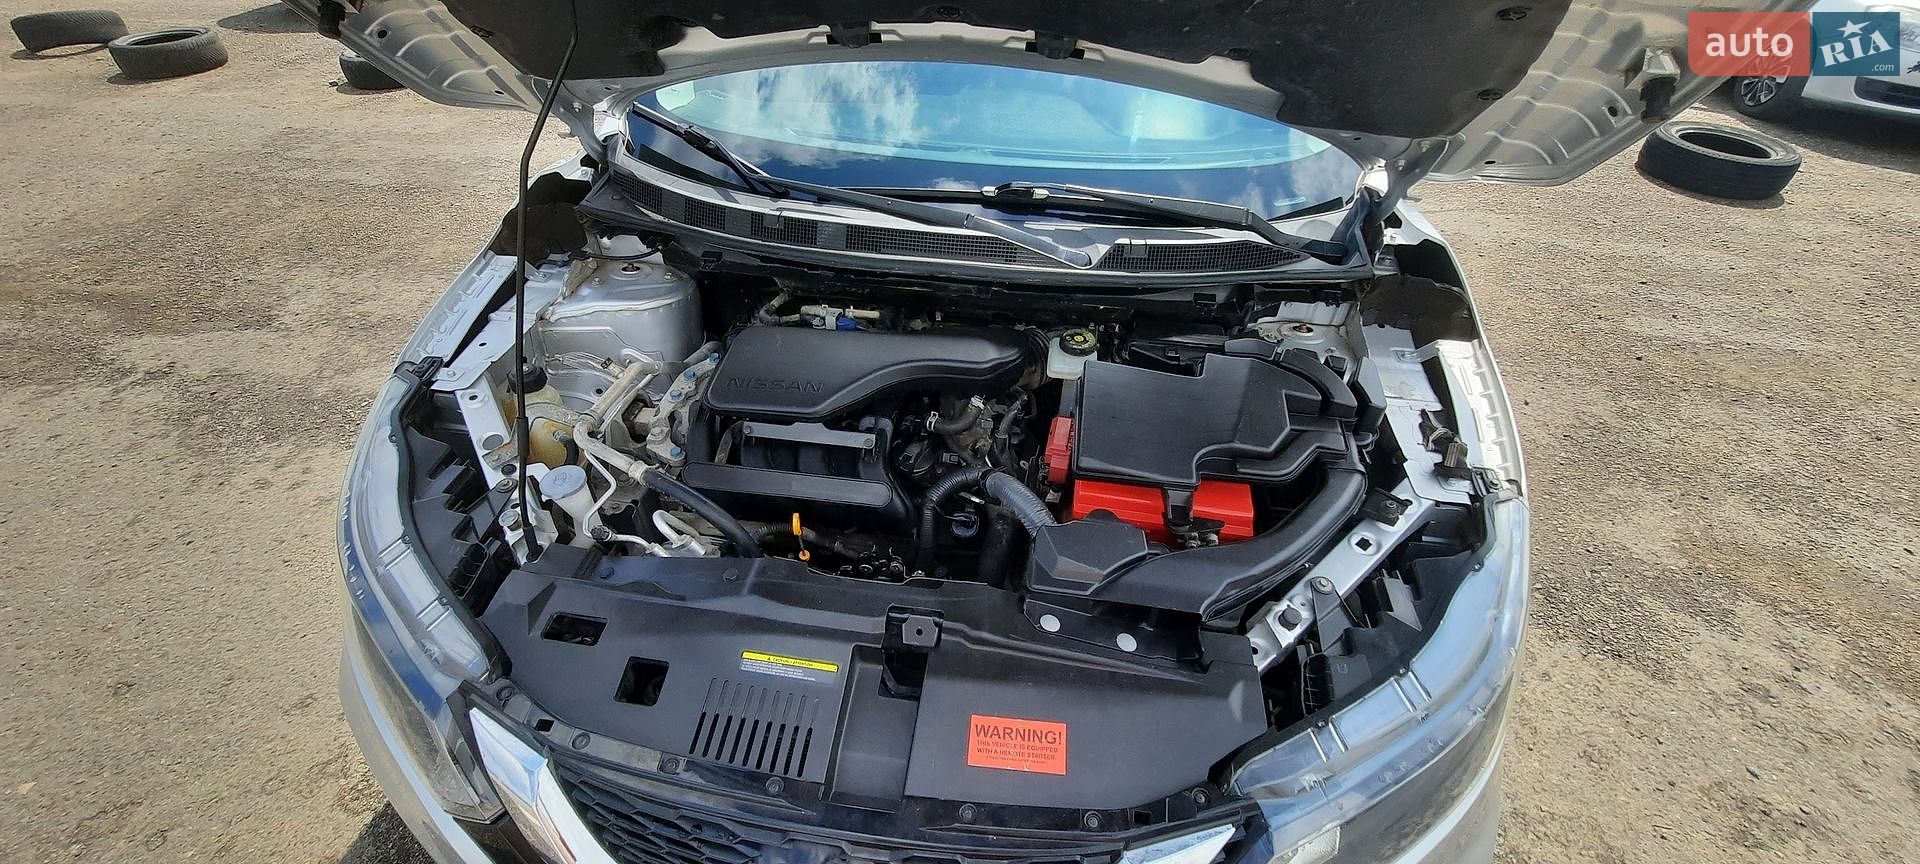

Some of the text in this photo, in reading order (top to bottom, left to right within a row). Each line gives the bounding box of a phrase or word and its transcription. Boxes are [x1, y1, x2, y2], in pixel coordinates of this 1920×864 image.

[726, 377, 824, 392] NISSAN
[975, 724, 1062, 745] WARNING!
[992, 741, 1017, 749] VEHICLE
[1027, 745, 1058, 753] EQUIPPED
[1000, 750, 1025, 758] REMOTE
